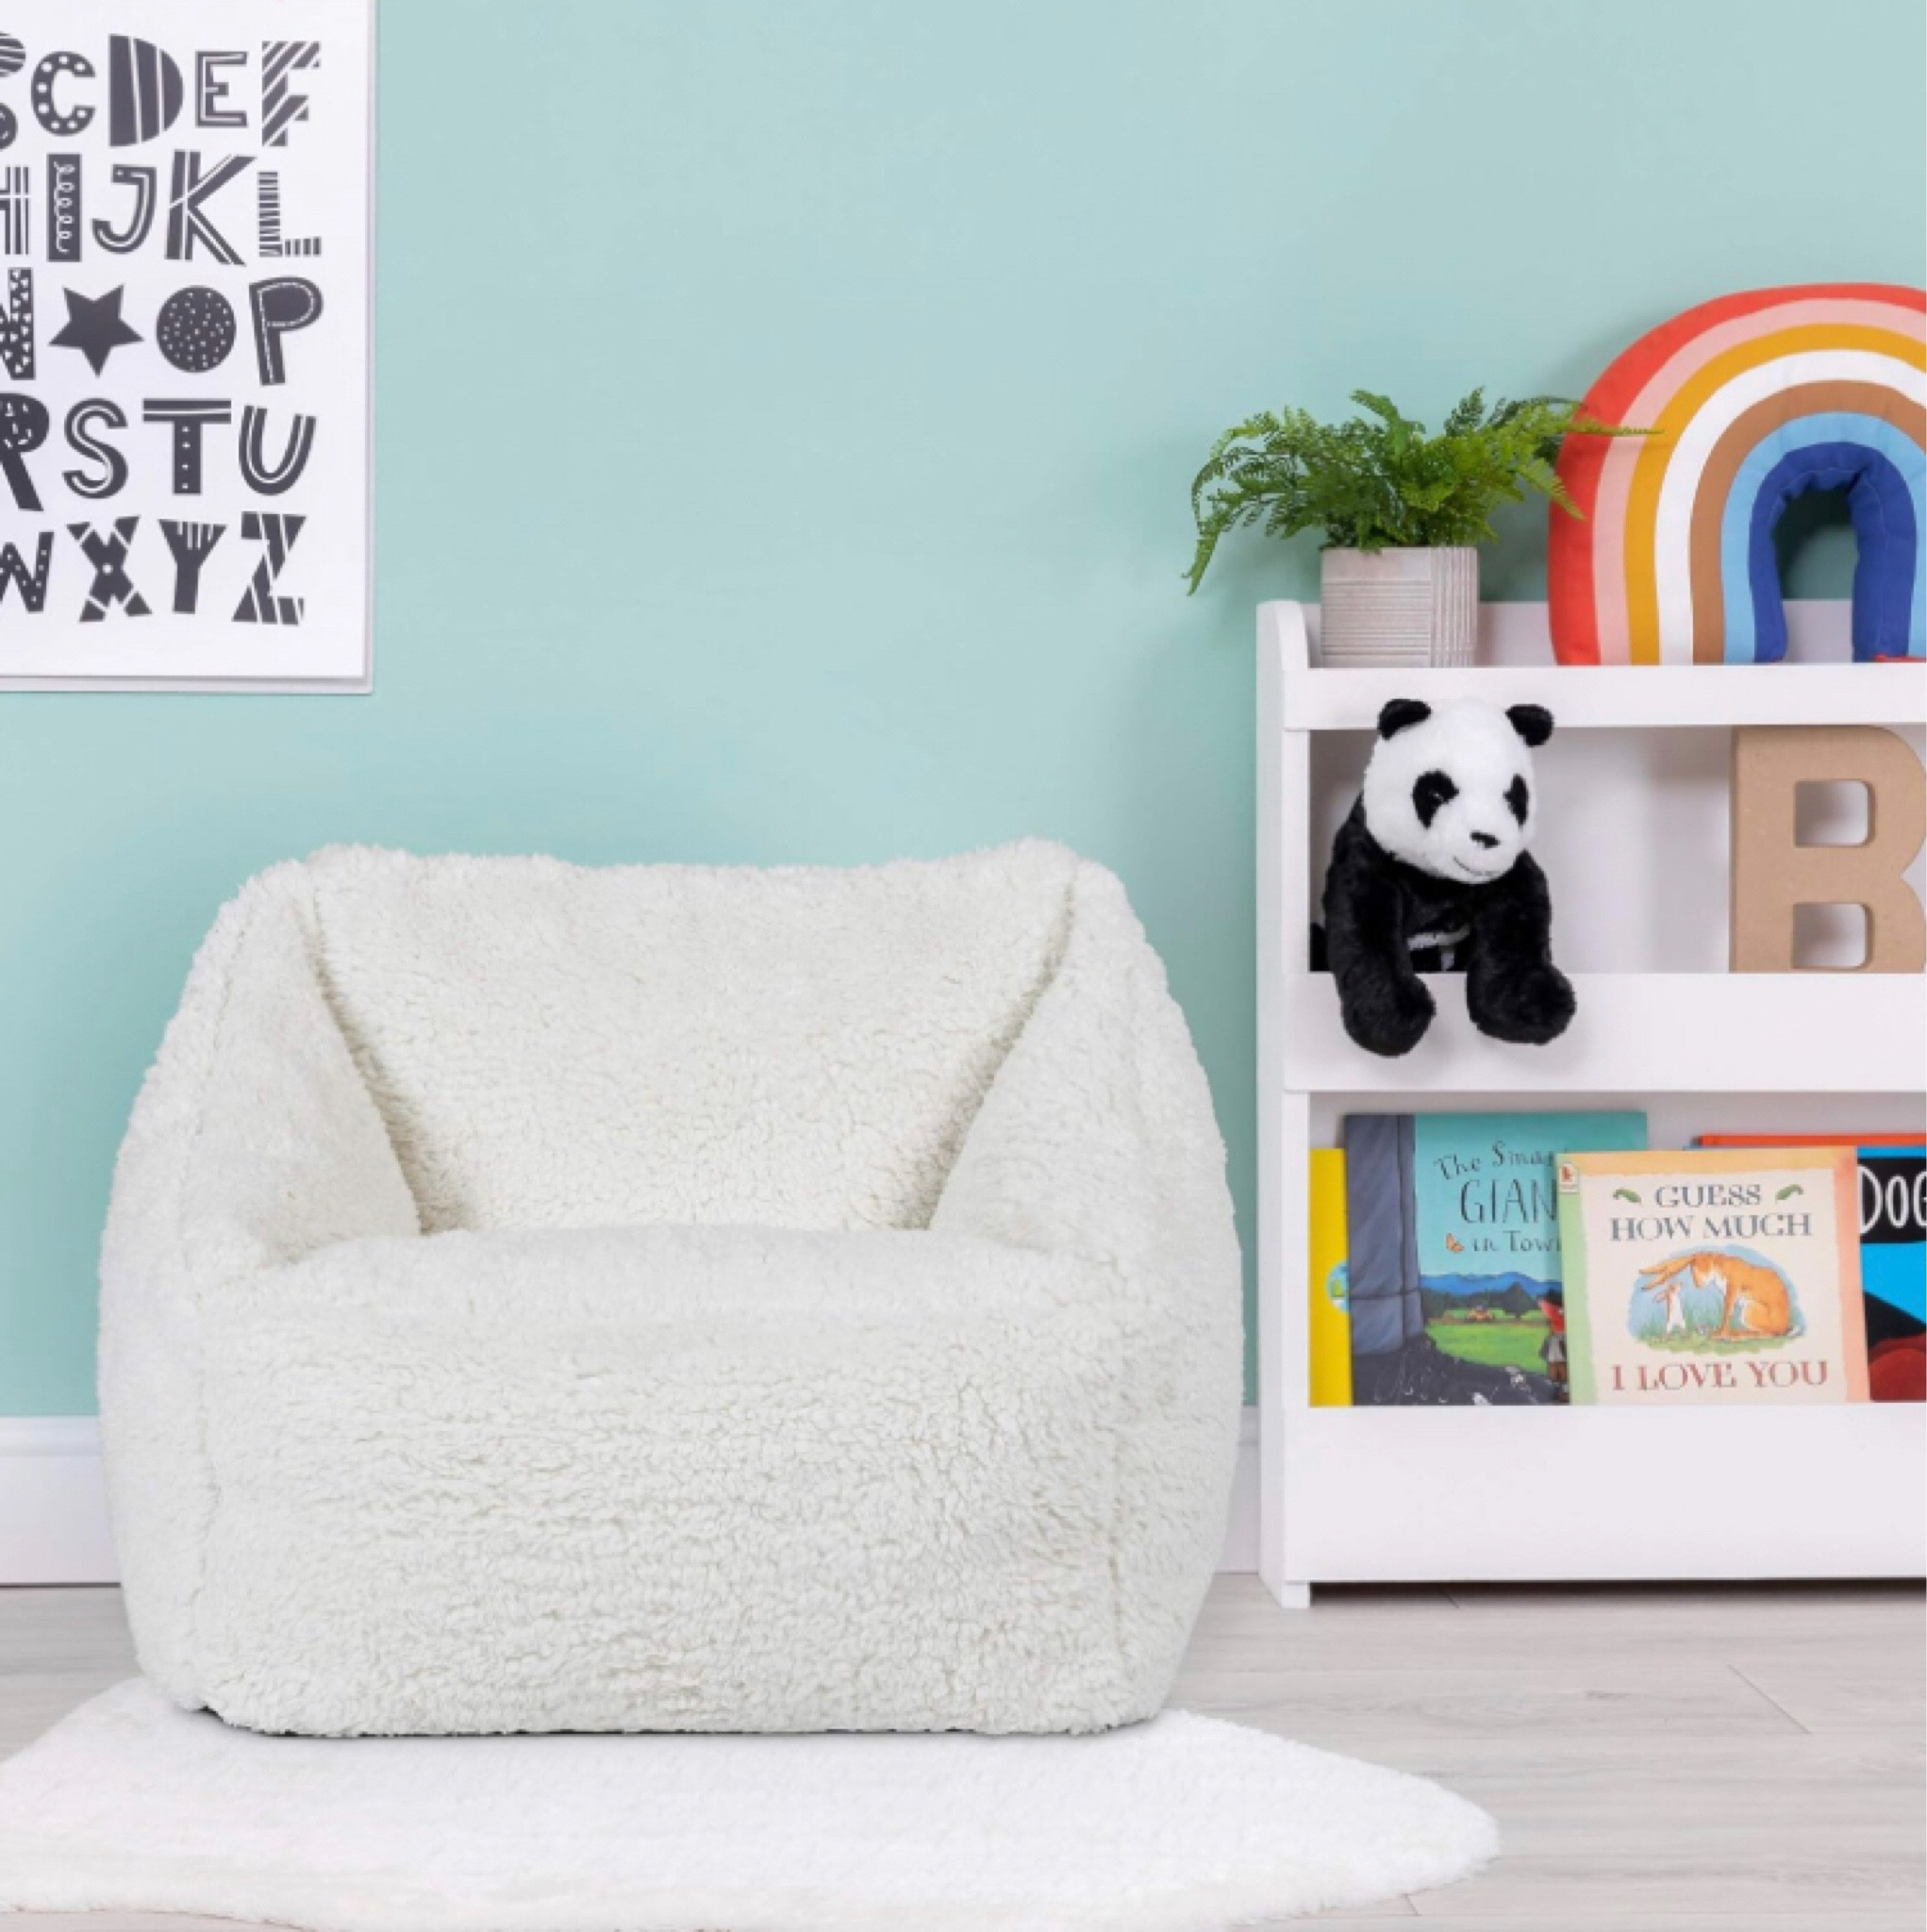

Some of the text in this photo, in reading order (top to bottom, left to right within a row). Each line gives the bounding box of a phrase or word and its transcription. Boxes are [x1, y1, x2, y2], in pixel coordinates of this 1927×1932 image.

[1434, 1153, 1480, 1180] The
[1655, 1184, 1761, 1208] GUESS
[1610, 1212, 1812, 1241] HOW MUCH
[1612, 1359, 1828, 1391] I LOVE YOU
